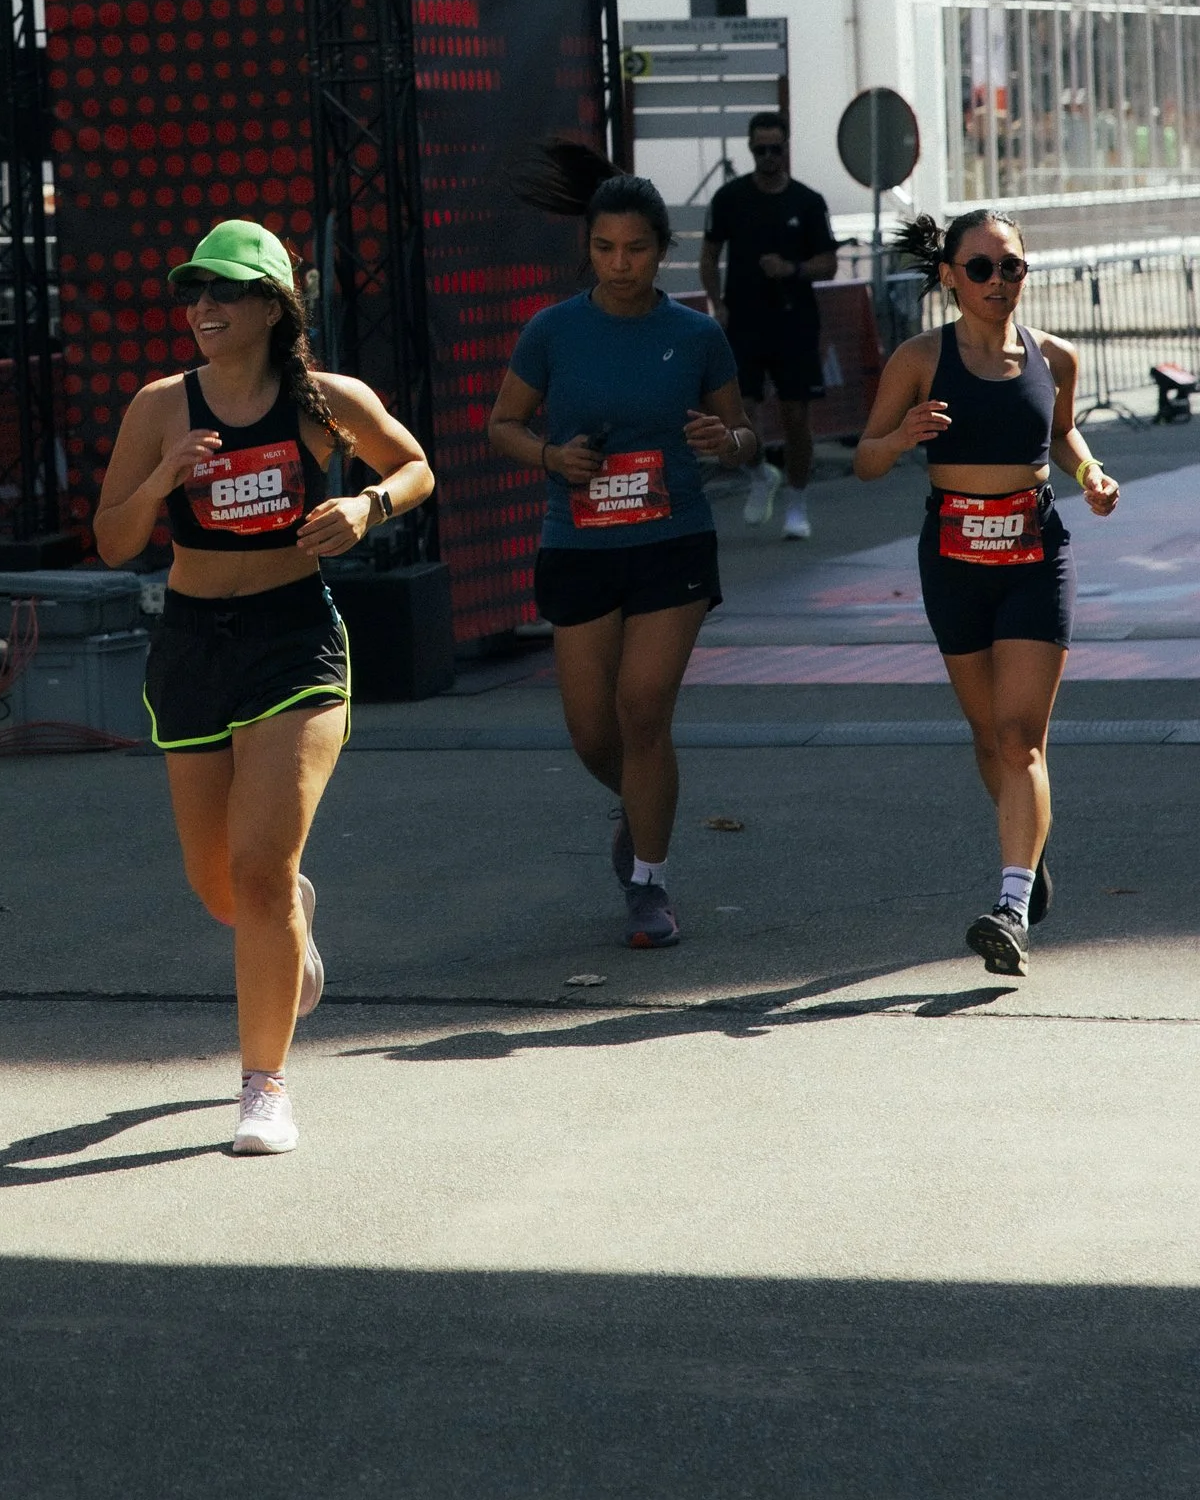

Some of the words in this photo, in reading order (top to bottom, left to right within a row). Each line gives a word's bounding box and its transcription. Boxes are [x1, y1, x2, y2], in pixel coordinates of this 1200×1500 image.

[263, 451, 281, 460] HEAT
[211, 468, 282, 507] 689
[589, 472, 649, 500] 562
[211, 497, 291, 521] SAMANTHA
[962, 514, 1025, 537] 560
